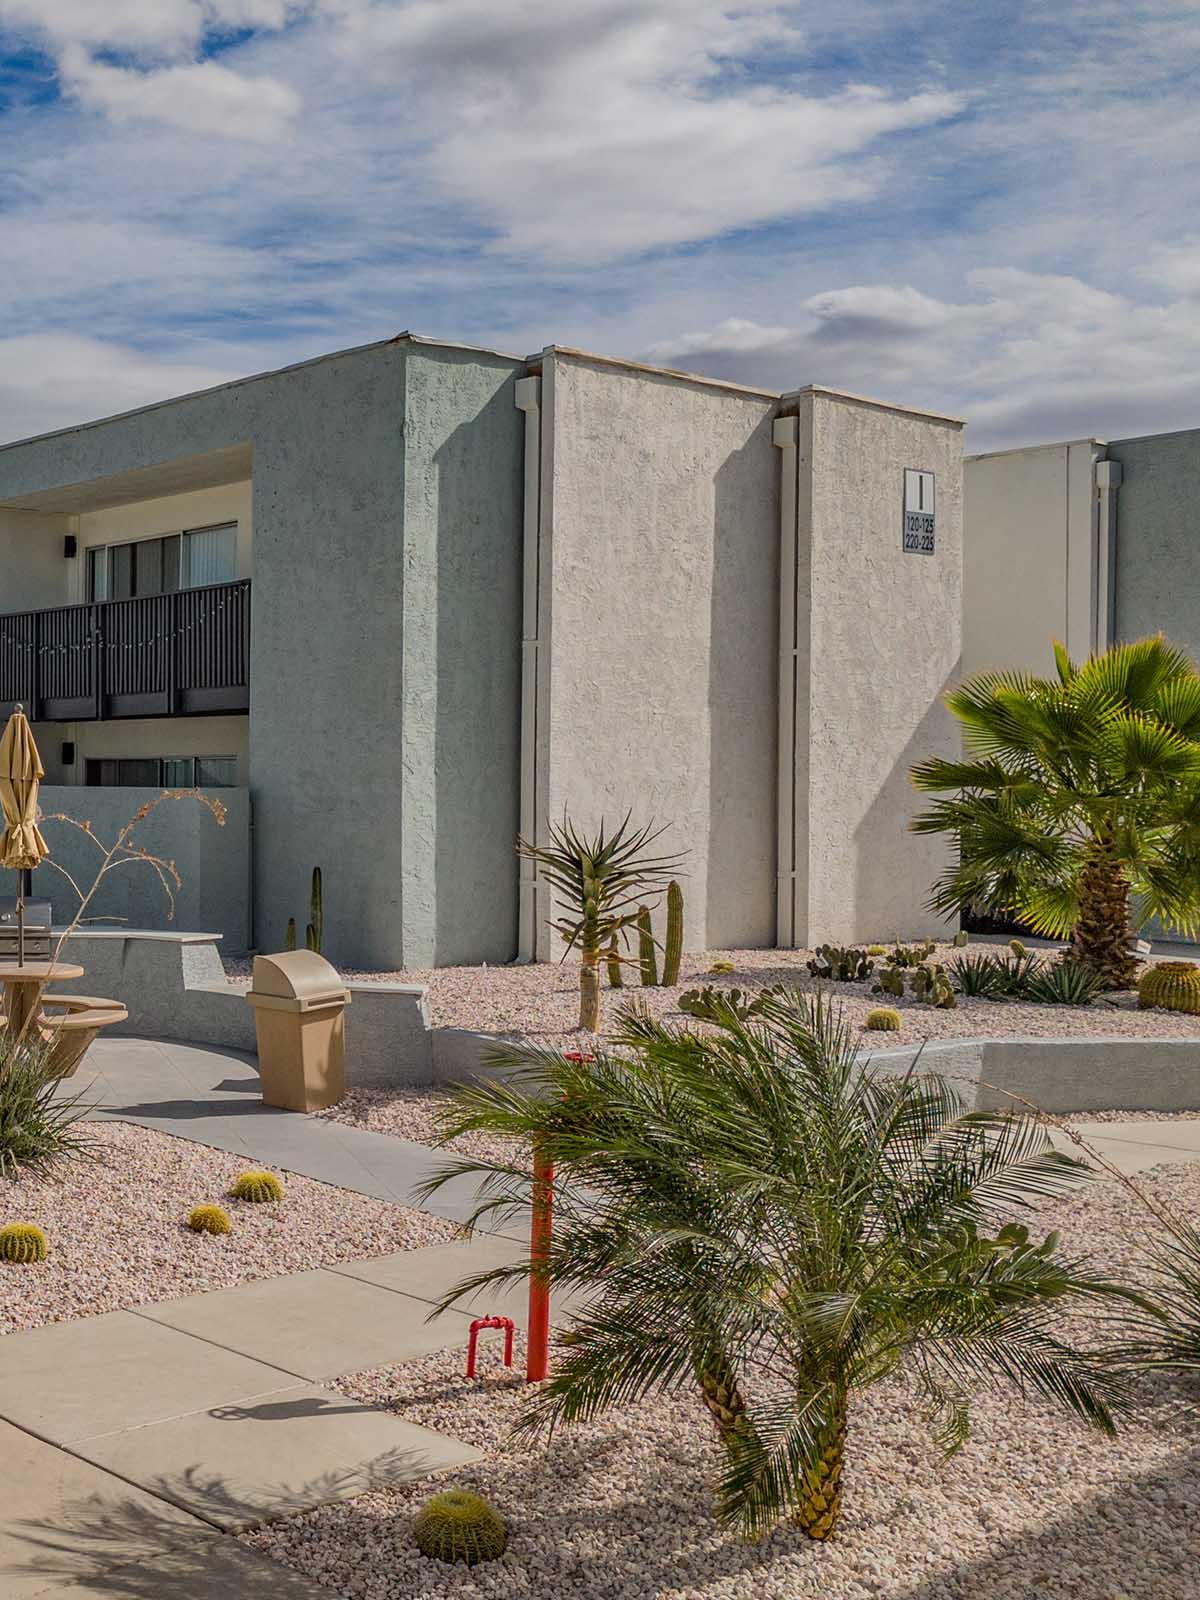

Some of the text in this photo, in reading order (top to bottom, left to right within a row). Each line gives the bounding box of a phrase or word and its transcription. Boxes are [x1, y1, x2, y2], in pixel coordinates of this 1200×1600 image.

[919, 475, 923, 510] I
[907, 516, 934, 533] 120-125
[906, 534, 934, 550] 220-225
